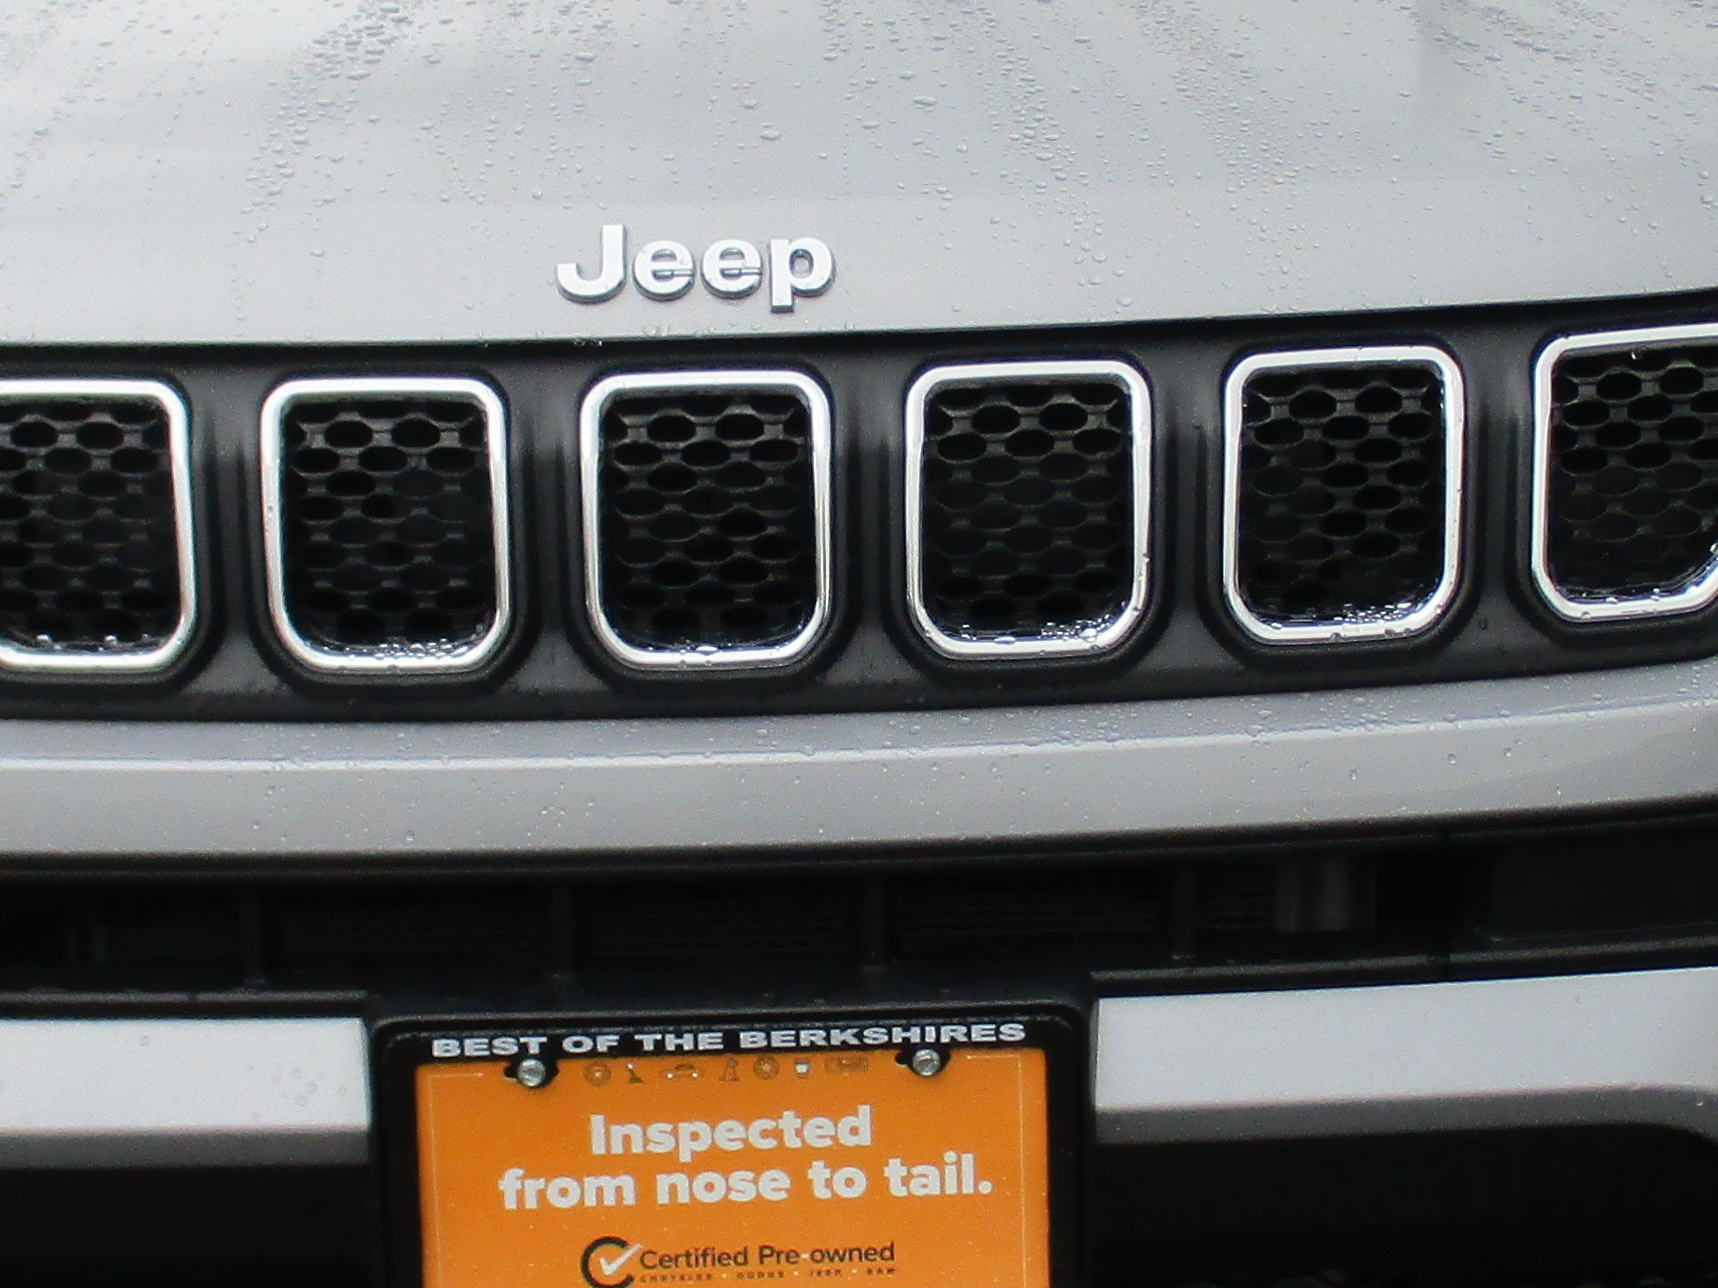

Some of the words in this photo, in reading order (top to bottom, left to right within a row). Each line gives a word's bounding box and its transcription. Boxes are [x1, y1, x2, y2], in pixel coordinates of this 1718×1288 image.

[554, 224, 836, 313] Jeep
[432, 1036, 548, 1058] BEST
[561, 1034, 621, 1054] OF
[634, 1031, 724, 1052] THE
[738, 1023, 1027, 1050] BERKSHIRES
[589, 1104, 873, 1163] Inspected
[498, 1166, 637, 1210] from
[656, 1168, 792, 1205] nose
[807, 1159, 867, 1200] to
[883, 1149, 994, 1198] tail.
[638, 1244, 749, 1270] Certified
[758, 1241, 896, 1266] Pre-owned
